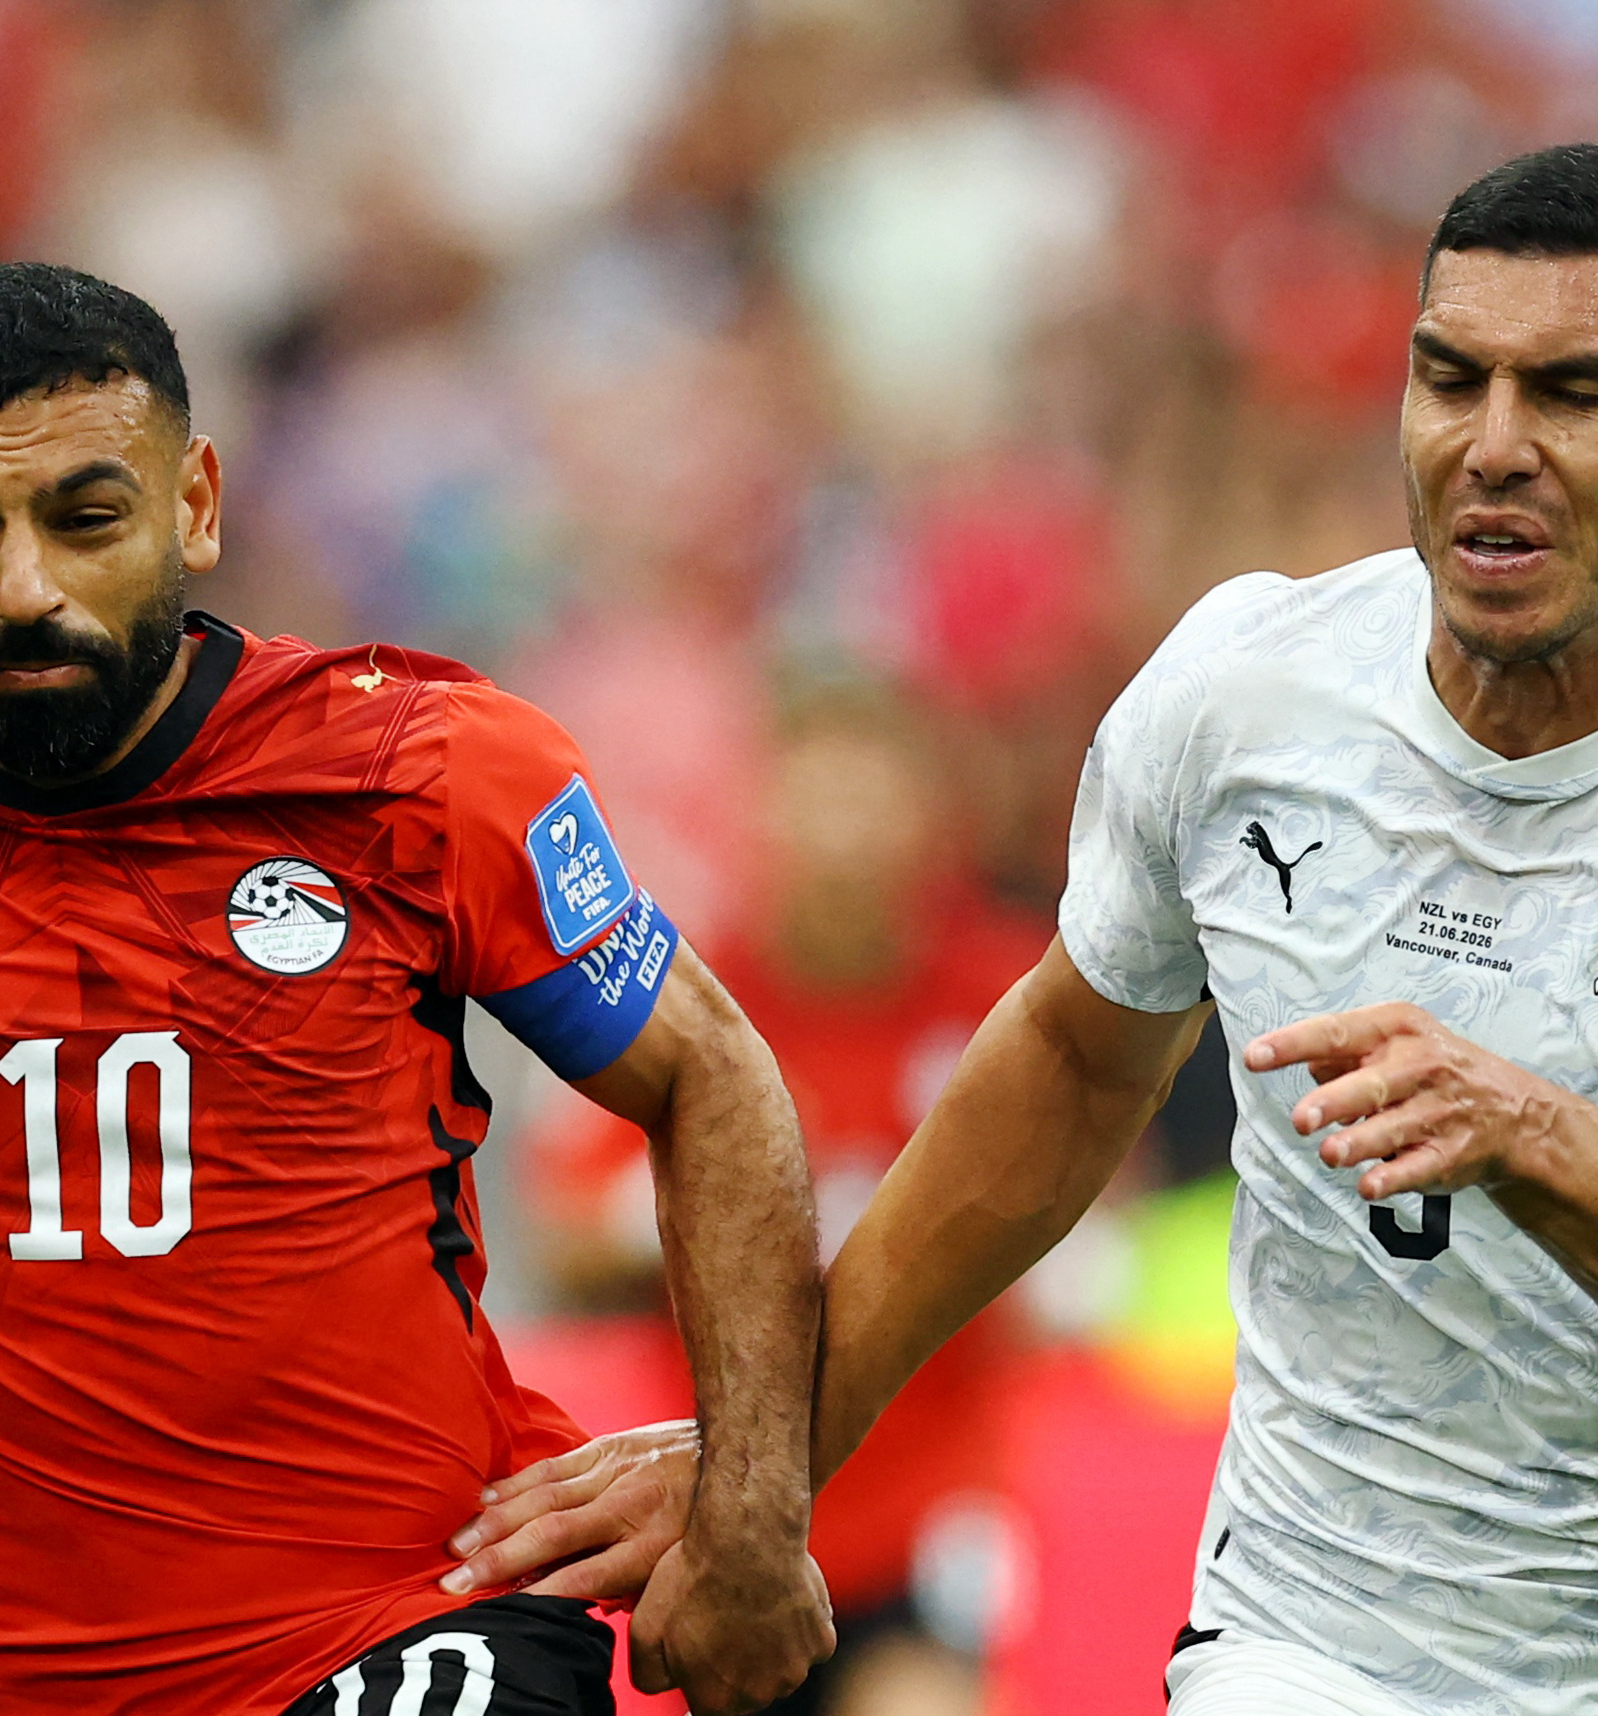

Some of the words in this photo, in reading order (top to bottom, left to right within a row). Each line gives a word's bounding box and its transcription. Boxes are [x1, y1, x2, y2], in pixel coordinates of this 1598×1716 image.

[556, 857, 584, 892] Unite
[579, 842, 600, 871] For
[564, 863, 613, 913] PEACE
[582, 896, 611, 921] FIFA
[1419, 901, 1447, 919] NZL
[1451, 911, 1469, 923] vs
[1472, 913, 1503, 931] EGY
[597, 961, 631, 1007] the
[620, 885, 654, 961] Worl
[1419, 921, 1493, 949] 21.06.2026
[266, 954, 312, 966] EGYPTIAN
[312, 949, 324, 959] FA
[1386, 933, 1460, 963] Vancouver,
[1465, 952, 1513, 973] Canada
